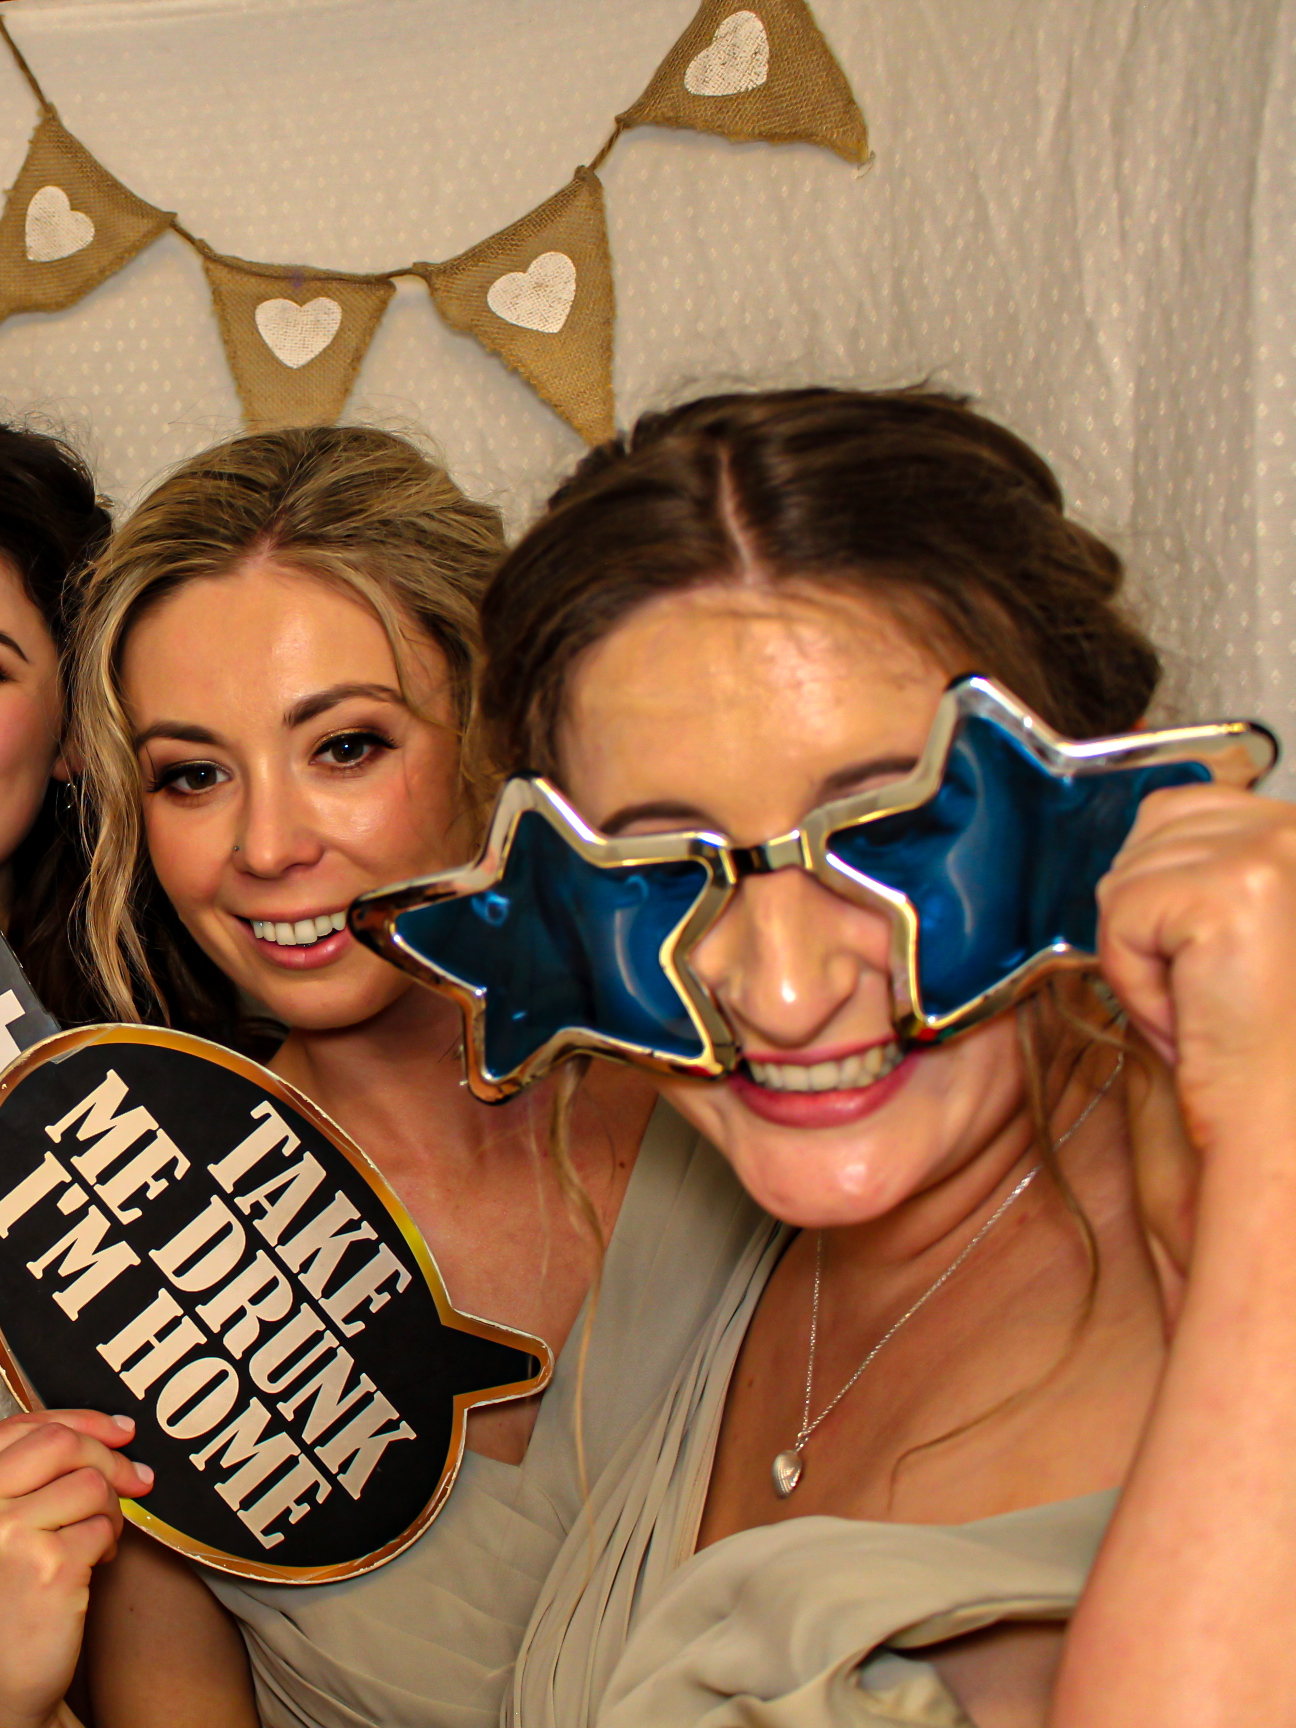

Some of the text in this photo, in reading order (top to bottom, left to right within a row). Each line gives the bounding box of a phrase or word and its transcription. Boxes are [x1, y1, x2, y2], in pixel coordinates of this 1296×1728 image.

[44, 1068, 417, 1500] ME DRUNK
[206, 1100, 413, 1338] TAKE
[95, 1287, 333, 1550] HOME
